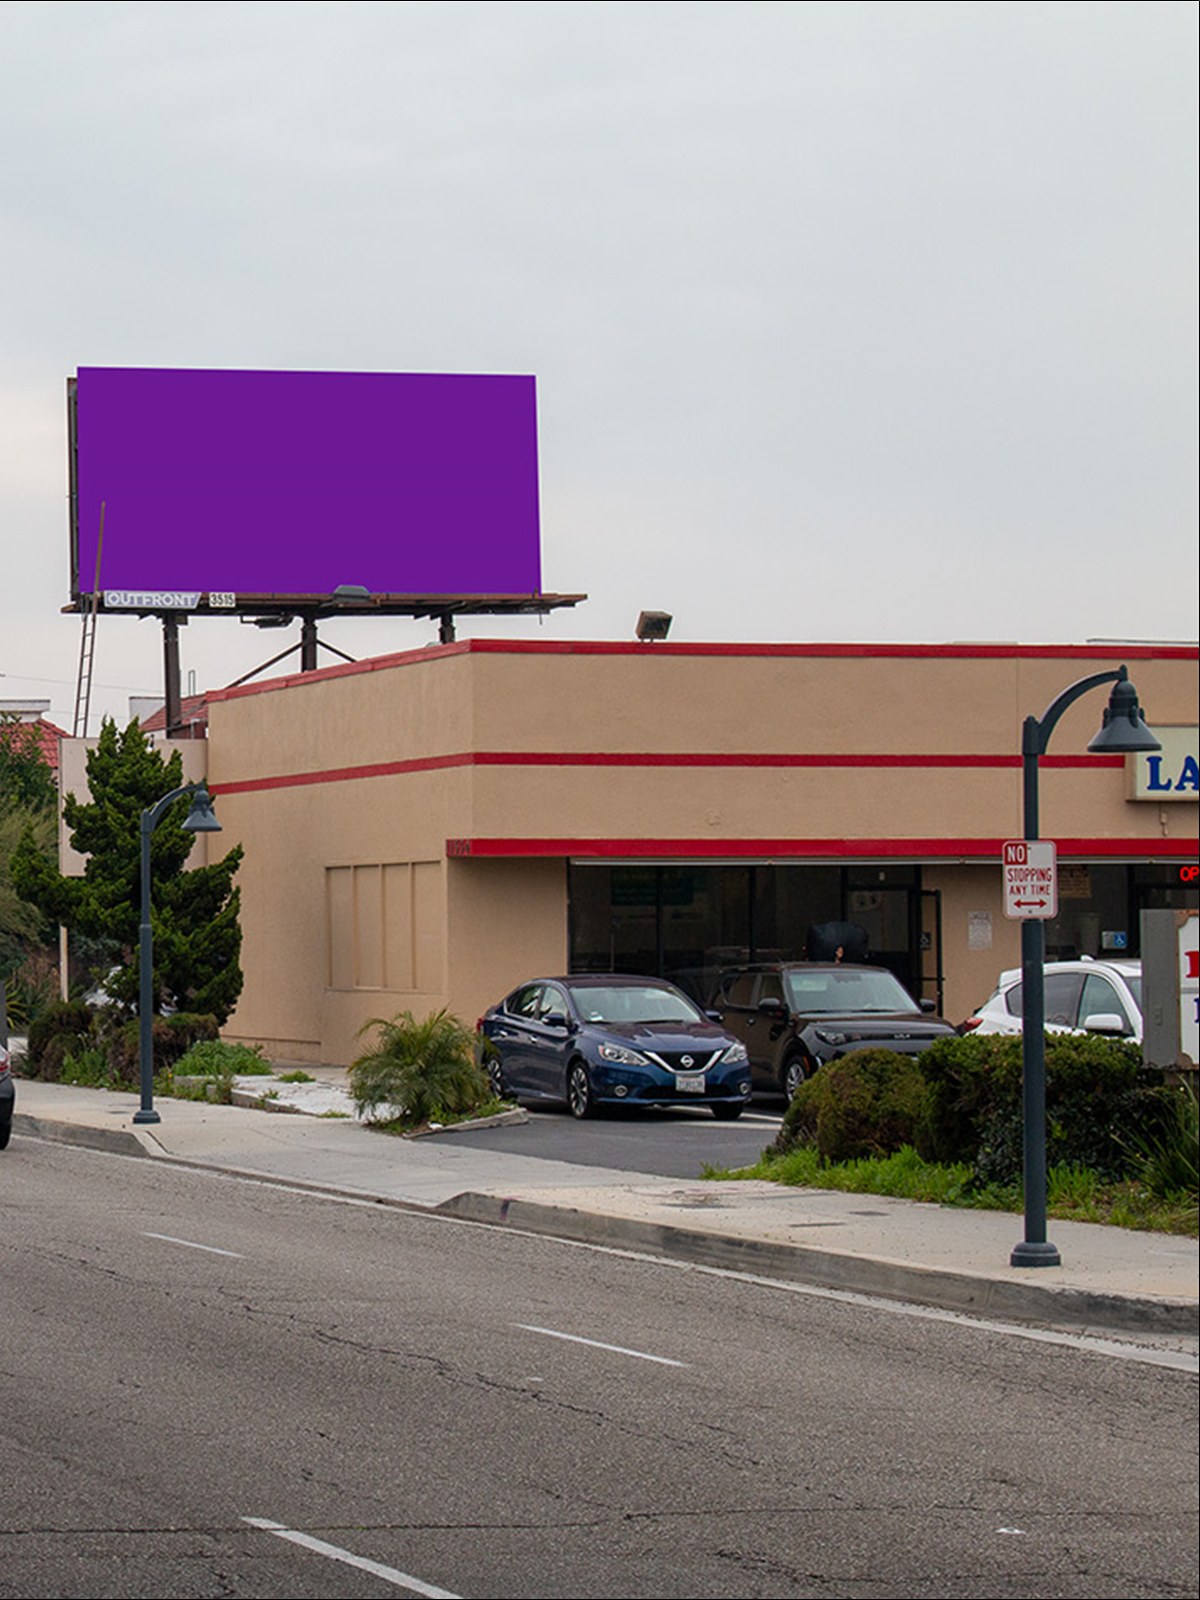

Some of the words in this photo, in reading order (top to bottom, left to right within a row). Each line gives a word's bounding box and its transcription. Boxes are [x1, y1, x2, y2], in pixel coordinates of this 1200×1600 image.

[107, 593, 195, 608] OUTFRONT
[210, 593, 233, 606] 3515
[1007, 845, 1025, 863] NO
[1007, 867, 1052, 883] STOPPING
[1009, 885, 1027, 896] ANY
[1031, 885, 1051, 896] TIME
